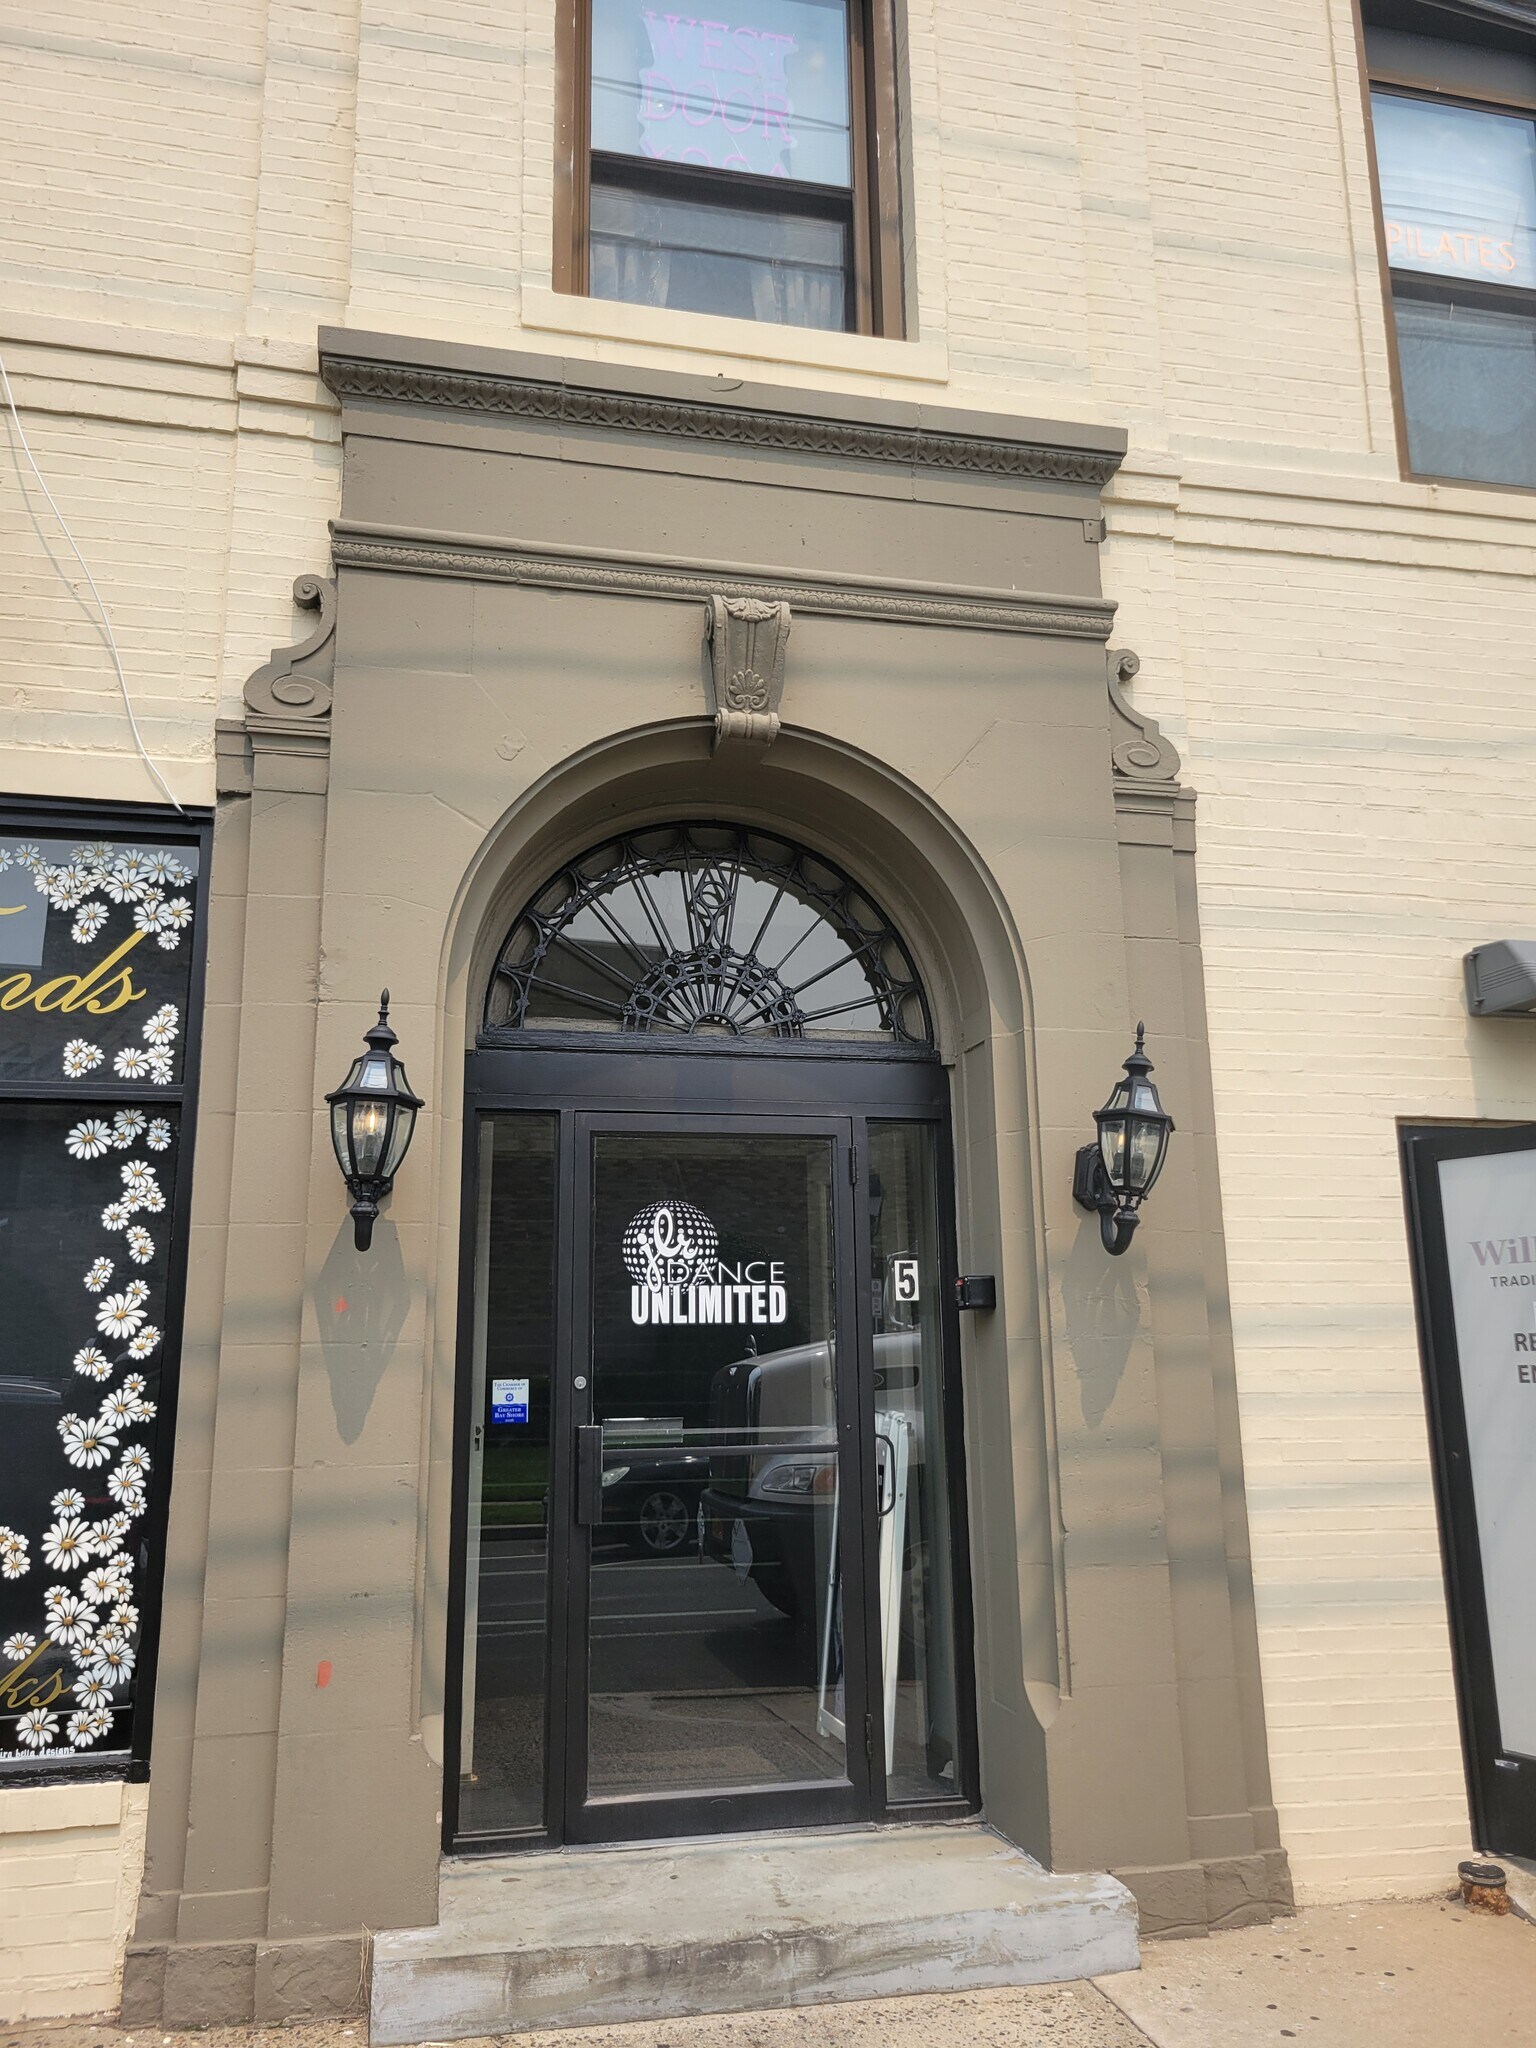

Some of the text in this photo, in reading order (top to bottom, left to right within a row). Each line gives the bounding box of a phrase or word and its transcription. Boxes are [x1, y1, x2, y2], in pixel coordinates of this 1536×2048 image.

[645, 11, 795, 81] WEST
[644, 70, 791, 142] DOOR
[1386, 222, 1516, 272] PILATES
[667, 1261, 786, 1284] DANCE
[898, 1262, 916, 1299] 5
[631, 1285, 787, 1325] UNLIMITED
